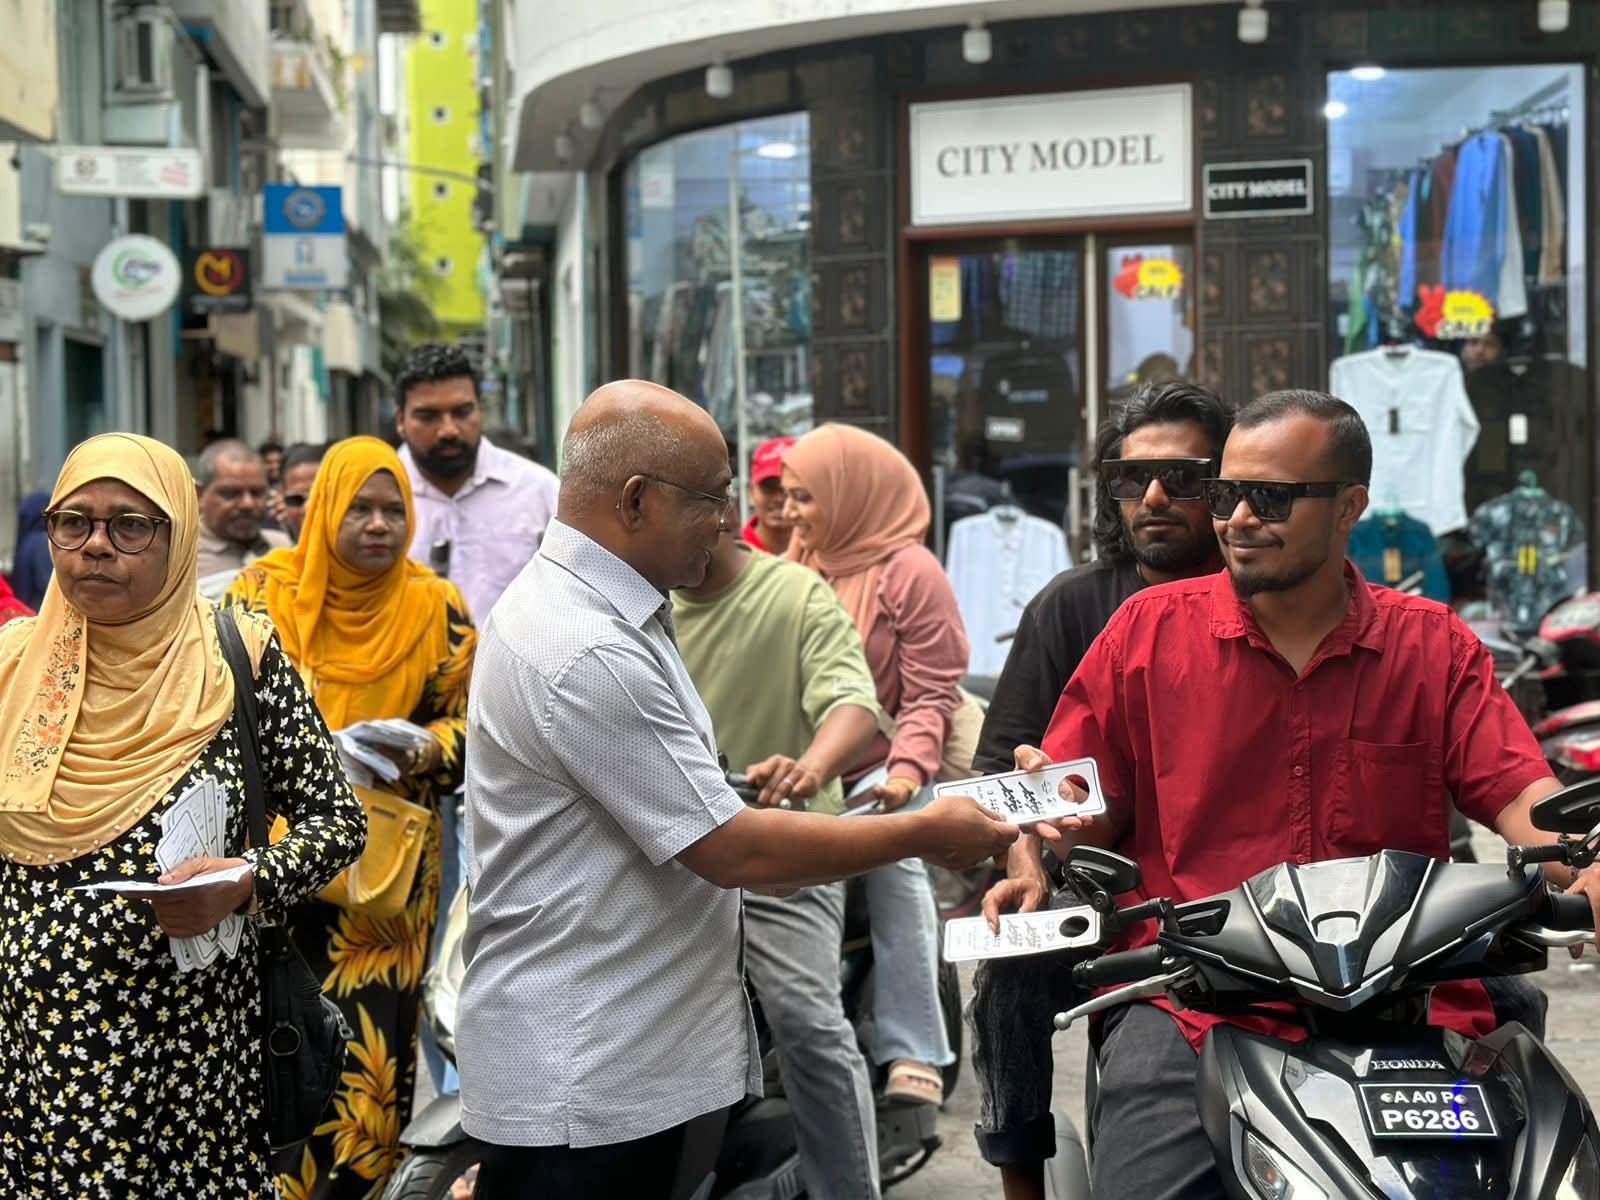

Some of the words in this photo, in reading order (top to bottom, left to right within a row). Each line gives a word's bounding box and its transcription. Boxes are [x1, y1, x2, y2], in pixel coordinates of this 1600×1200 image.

[936, 142, 1021, 178] CITY
[1028, 133, 1165, 172] MODEL
[1207, 182, 1247, 200] CITY
[1247, 179, 1305, 198] MODEL
[1371, 1059, 1446, 1070] HONDA
[1381, 1109, 1480, 1131] P6286
